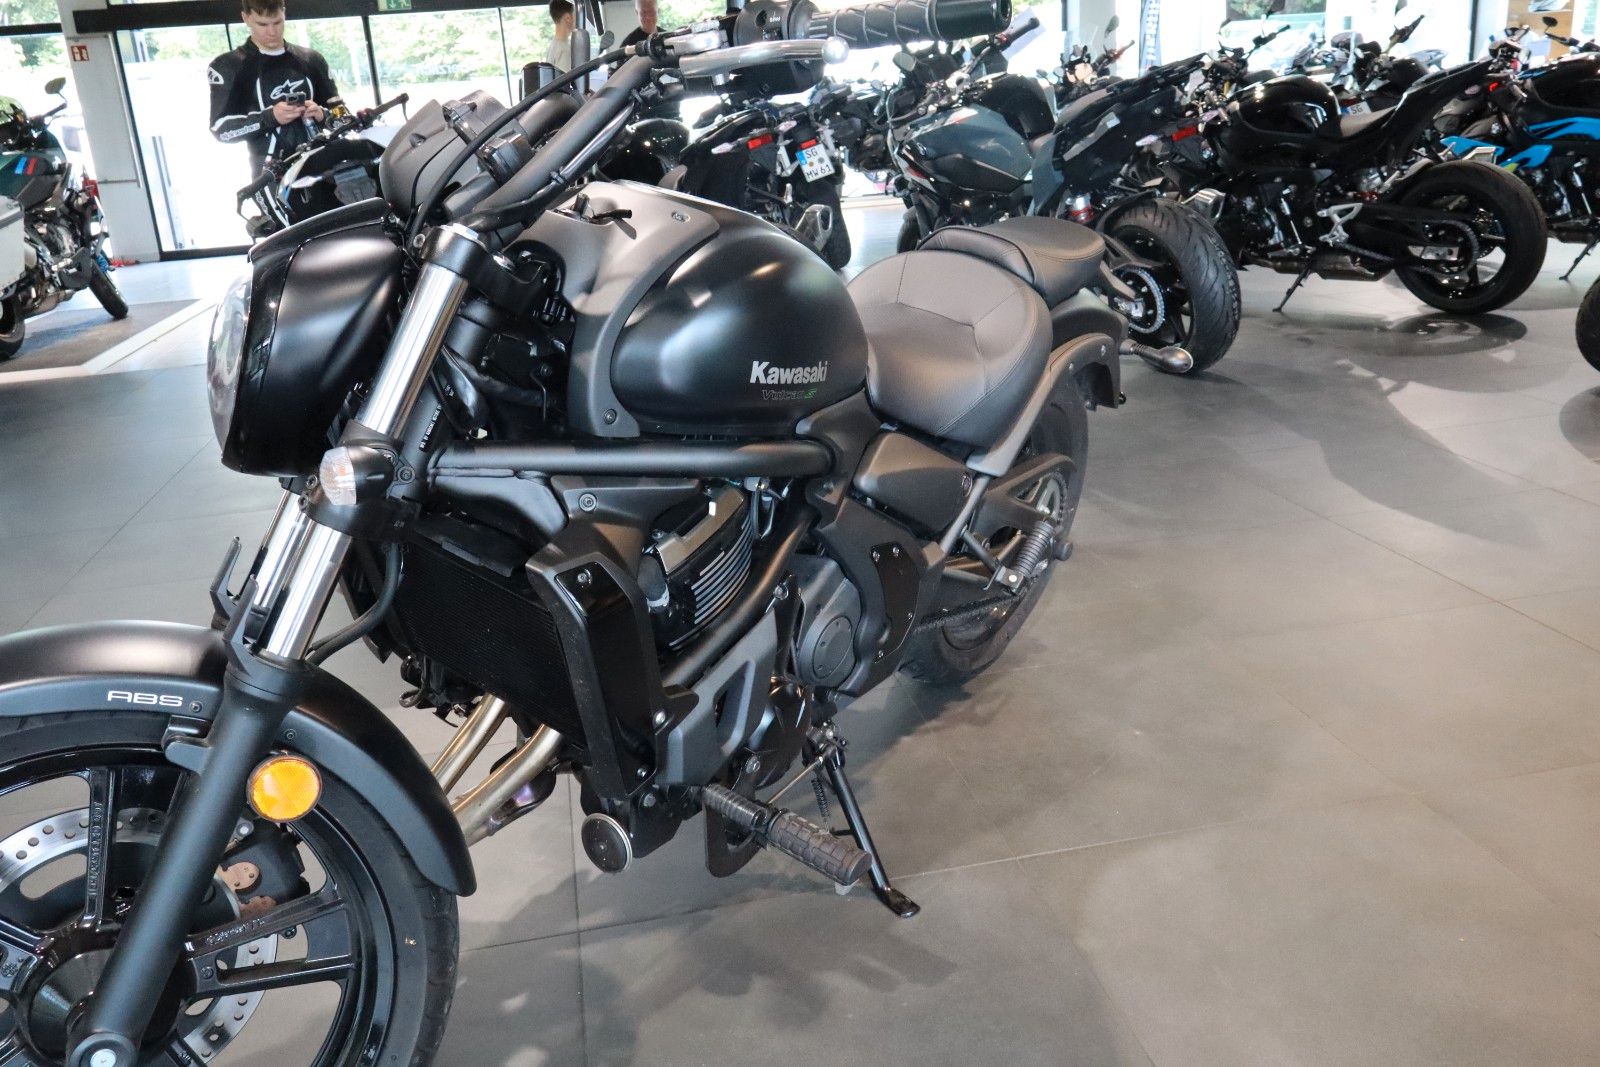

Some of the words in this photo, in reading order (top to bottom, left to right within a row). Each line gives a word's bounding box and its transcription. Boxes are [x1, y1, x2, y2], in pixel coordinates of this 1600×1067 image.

[805, 147, 818, 159] SG
[750, 361, 828, 384] Kawasaki
[107, 690, 184, 707] ABS
